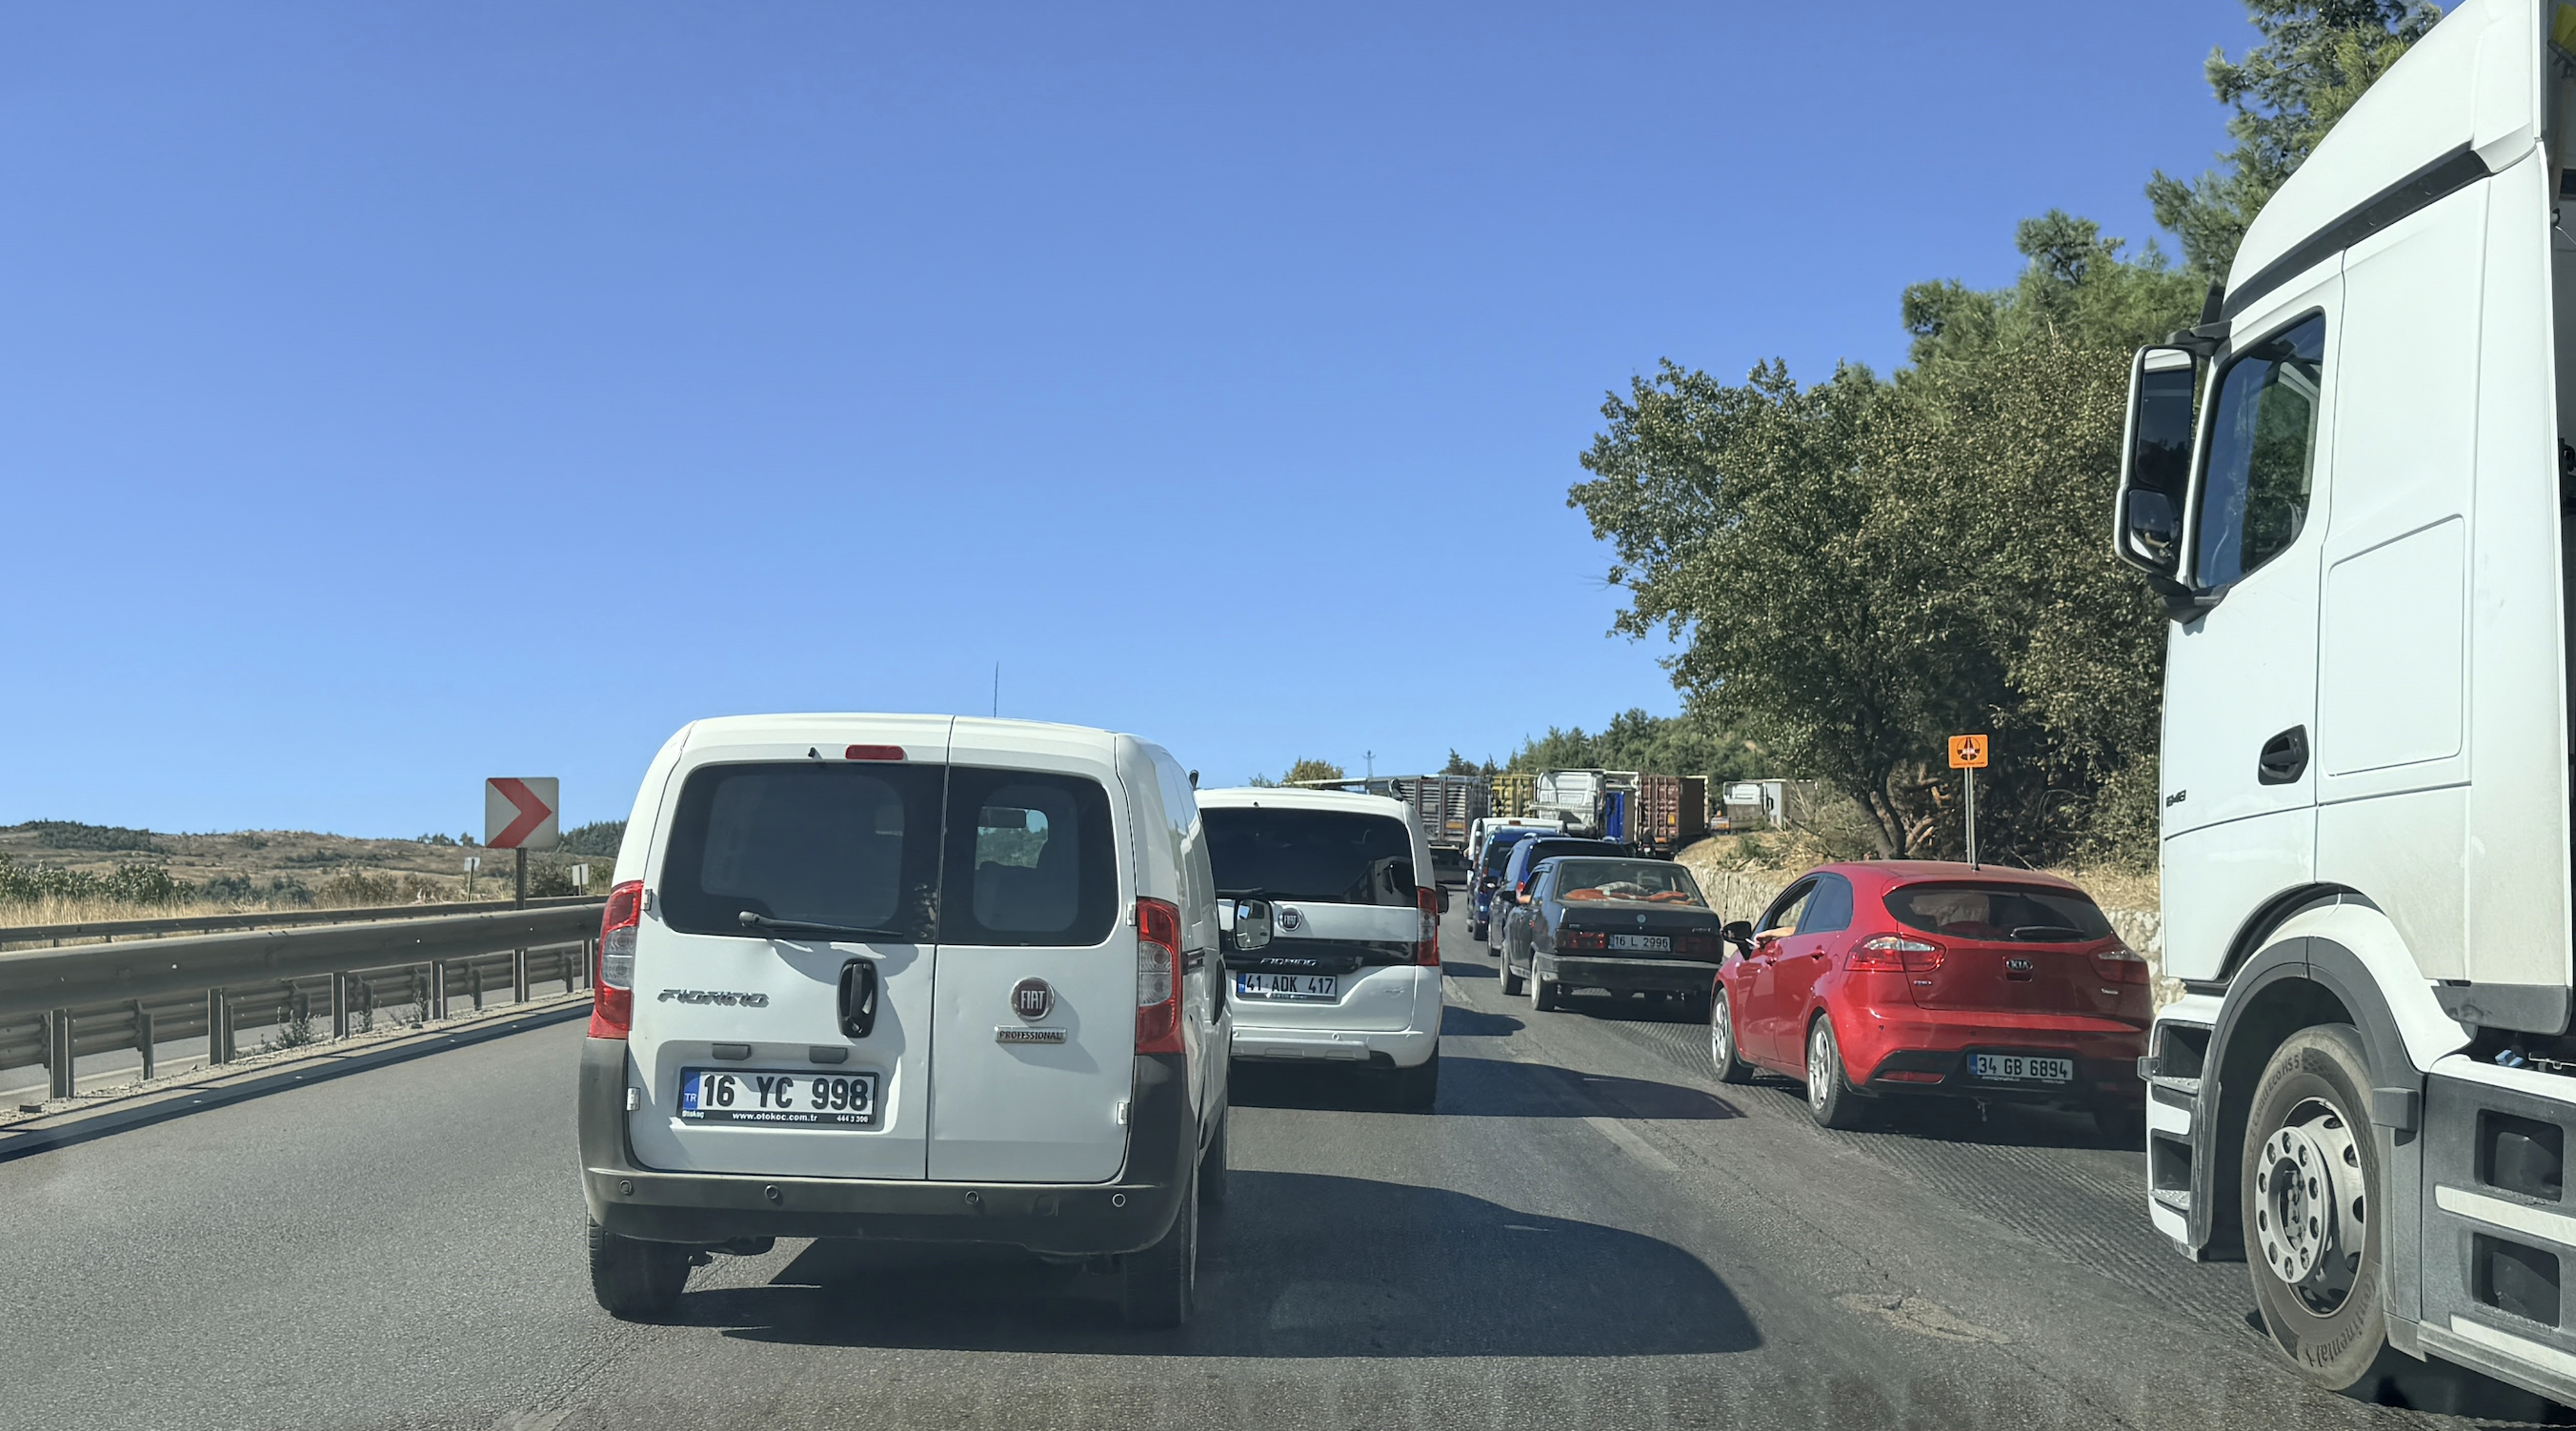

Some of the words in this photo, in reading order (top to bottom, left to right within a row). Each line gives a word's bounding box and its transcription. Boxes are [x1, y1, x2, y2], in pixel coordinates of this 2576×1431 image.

[1614, 935, 1626, 946] 16
[1631, 936, 1638, 947] L
[2009, 959, 2030, 969] KIA
[1246, 975, 1261, 991] 41
[1272, 976, 1298, 993] ADK
[1308, 978, 1334, 995] 417
[1020, 990, 1046, 1010] FIAT
[1979, 1058, 1997, 1074] 34
[2004, 1058, 2023, 1076] GB
[2030, 1059, 2067, 1078] 6894
[685, 1093, 696, 1102] TR
[704, 1075, 735, 1107] 16
[756, 1076, 794, 1108] YC
[811, 1078, 868, 1112] 998
[732, 1111, 818, 1122] www.otokoc.com.tr
